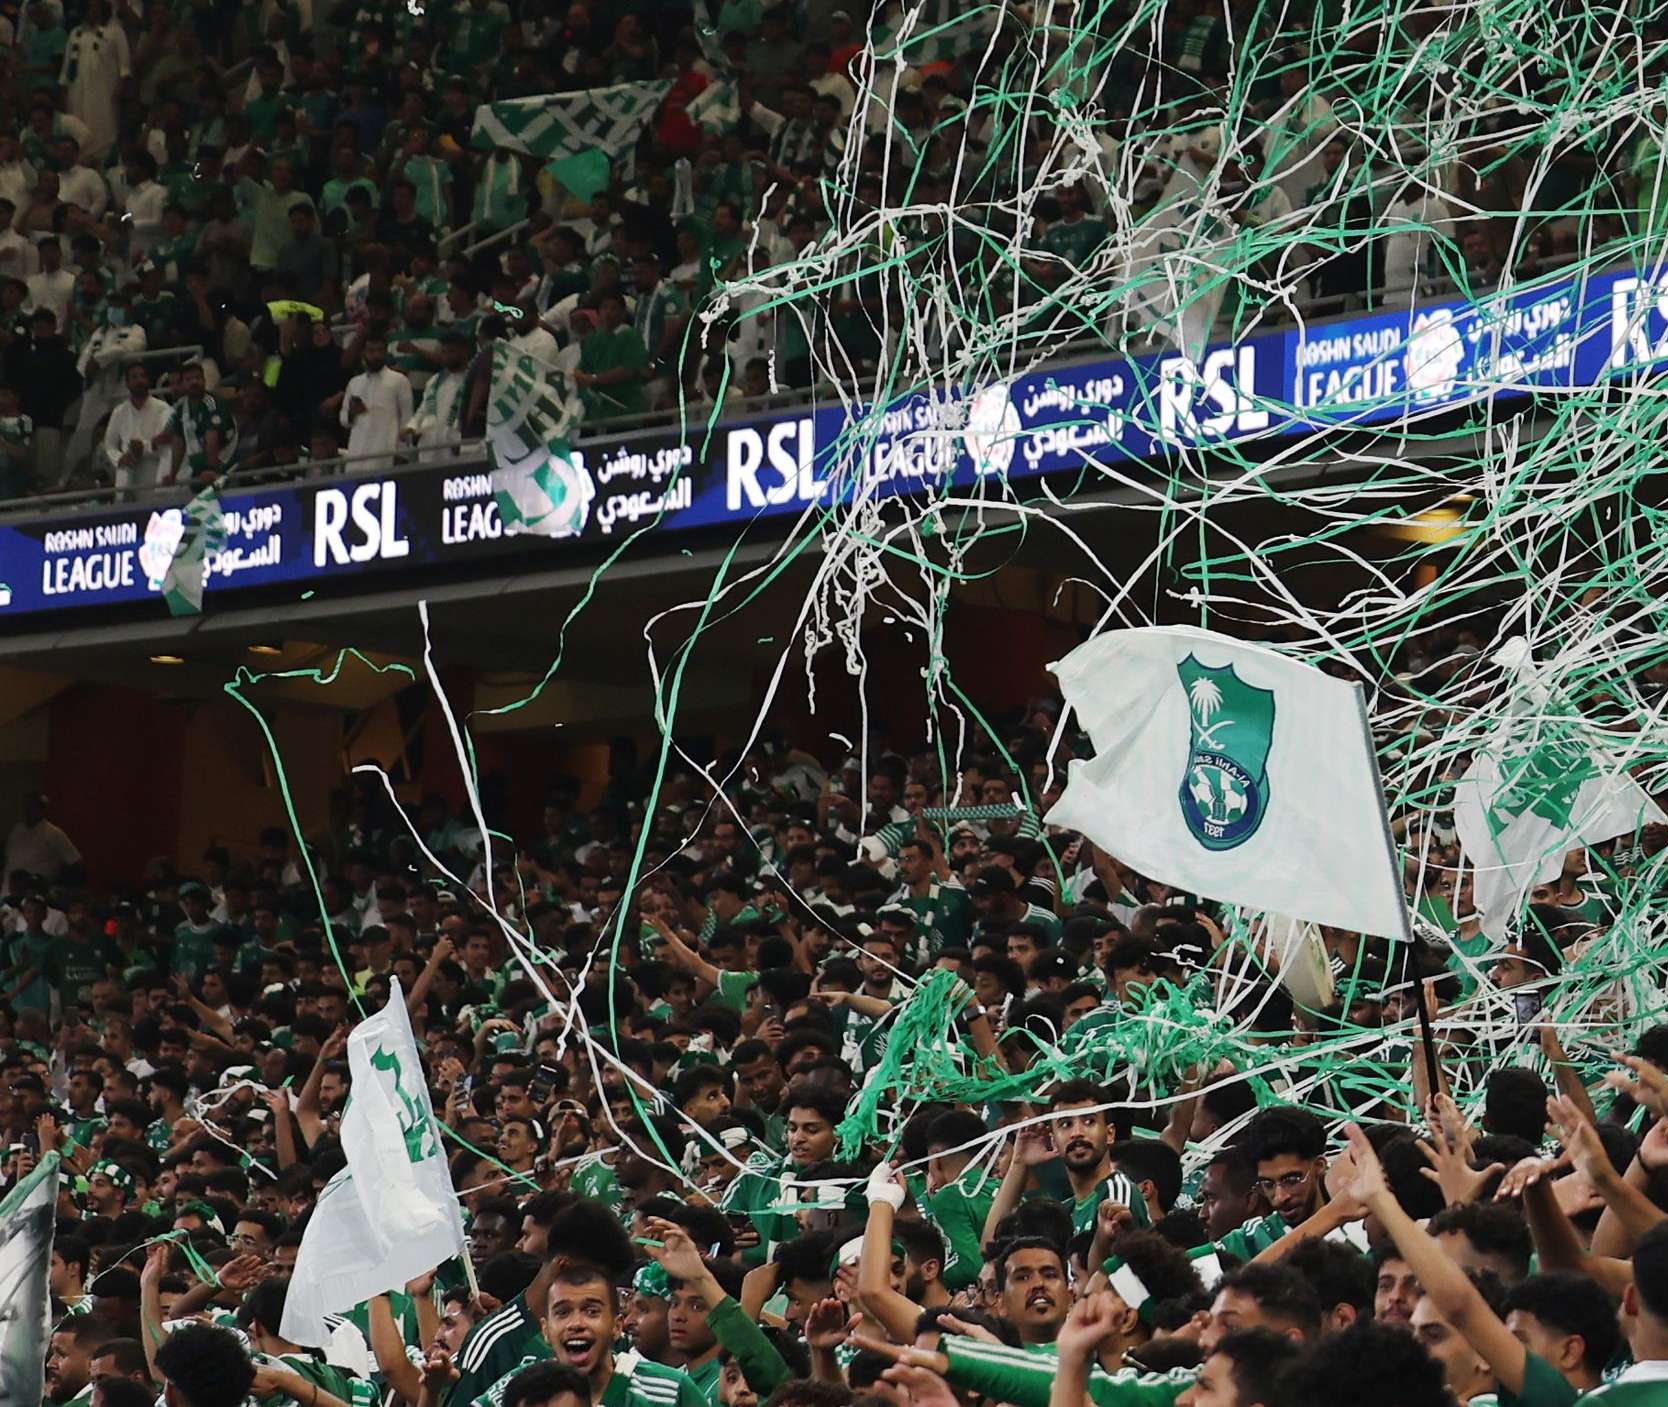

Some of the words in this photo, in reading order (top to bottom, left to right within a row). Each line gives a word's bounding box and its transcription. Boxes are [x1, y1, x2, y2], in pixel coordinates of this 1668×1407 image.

[1353, 326, 1401, 359] SAUDI
[1159, 345, 1269, 439] RSL
[1298, 358, 1400, 414] EAGUE
[597, 444, 647, 483] روشن
[648, 445, 692, 480] دوري
[726, 418, 828, 511] RSL
[443, 473, 493, 502] ROSHN
[596, 478, 692, 535] السعودي
[44, 529, 93, 553] ROSHN
[94, 521, 138, 549] SAUDI
[242, 503, 282, 537] دوري
[313, 480, 410, 568] RSL
[442, 500, 502, 545] LEAG
[43, 549, 134, 595] LEAGUE
